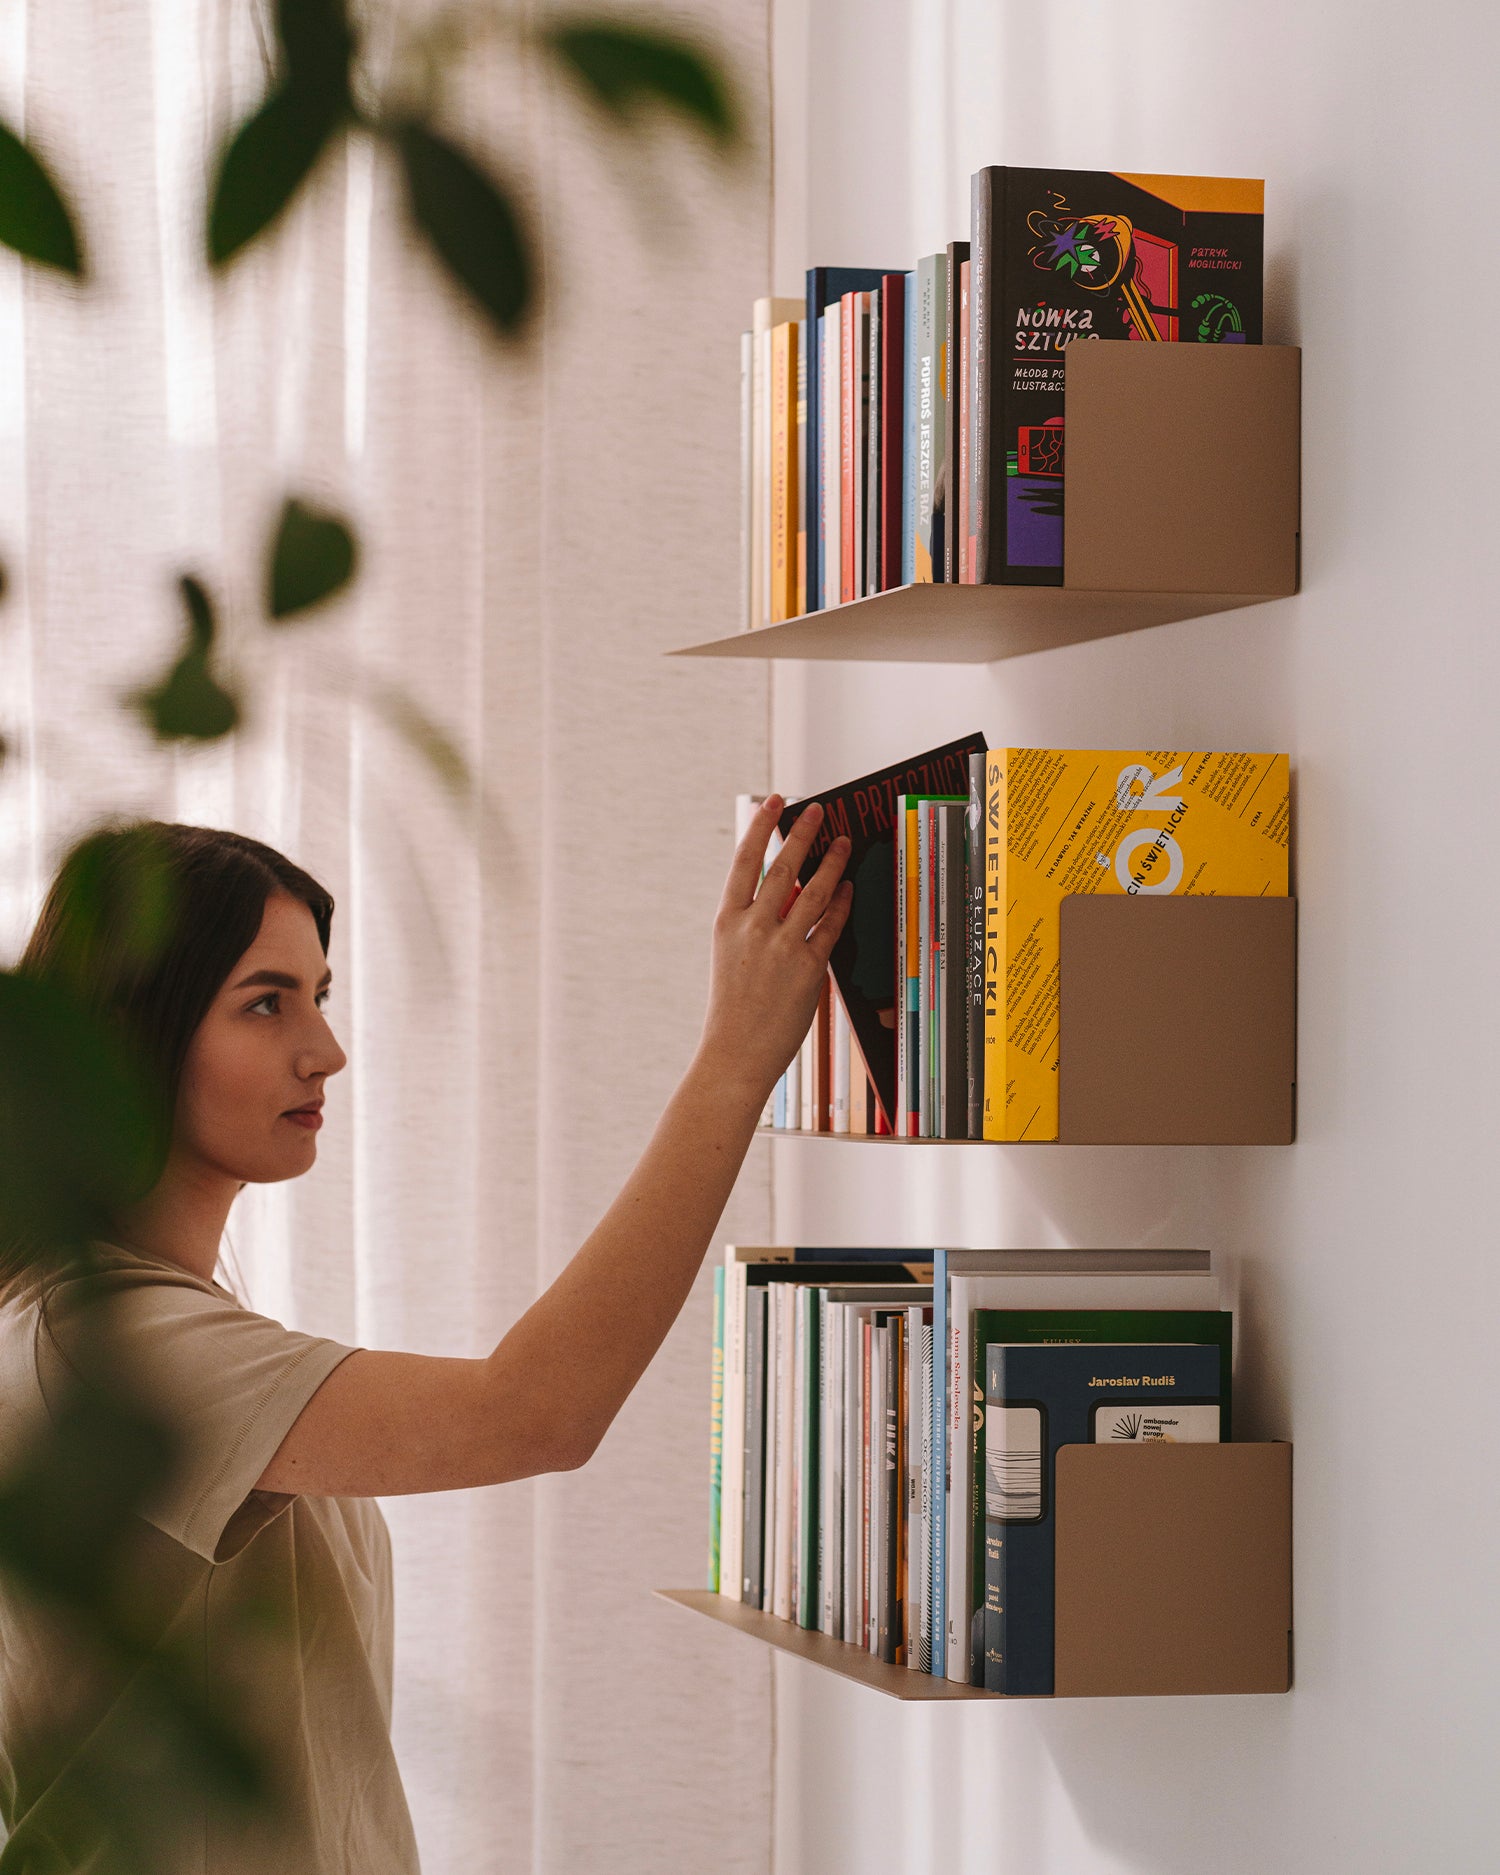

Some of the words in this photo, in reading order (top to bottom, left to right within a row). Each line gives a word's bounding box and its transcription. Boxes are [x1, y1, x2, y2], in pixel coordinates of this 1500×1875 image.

[1188, 259, 1242, 270] MOGILNICKI
[1190, 247, 1229, 257] PATRYK
[1015, 331, 1100, 352] SZTU
[921, 355, 932, 420] POPROŚ
[920, 423, 931, 491] JESZCZE
[919, 493, 930, 526] RAZ
[1188, 774, 1199, 786] TAK
[1250, 811, 1263, 827] CENA
[1140, 801, 1189, 872] ŚWIETLICKI
[1045, 867, 1056, 879] TAK
[1053, 843, 1072, 868] DAWNO,
[1067, 830, 1078, 842] TAK
[986, 763, 1004, 1016] ŚWIETLICKI
[953, 1327, 961, 1359] Anna
[1088, 1376, 1141, 1388] Jaroslav
[1142, 1375, 1176, 1387] Rudiš
[953, 1362, 961, 1430] Sobolewska
[1142, 1430, 1165, 1438] europy
[1143, 1417, 1179, 1426] ambasador
